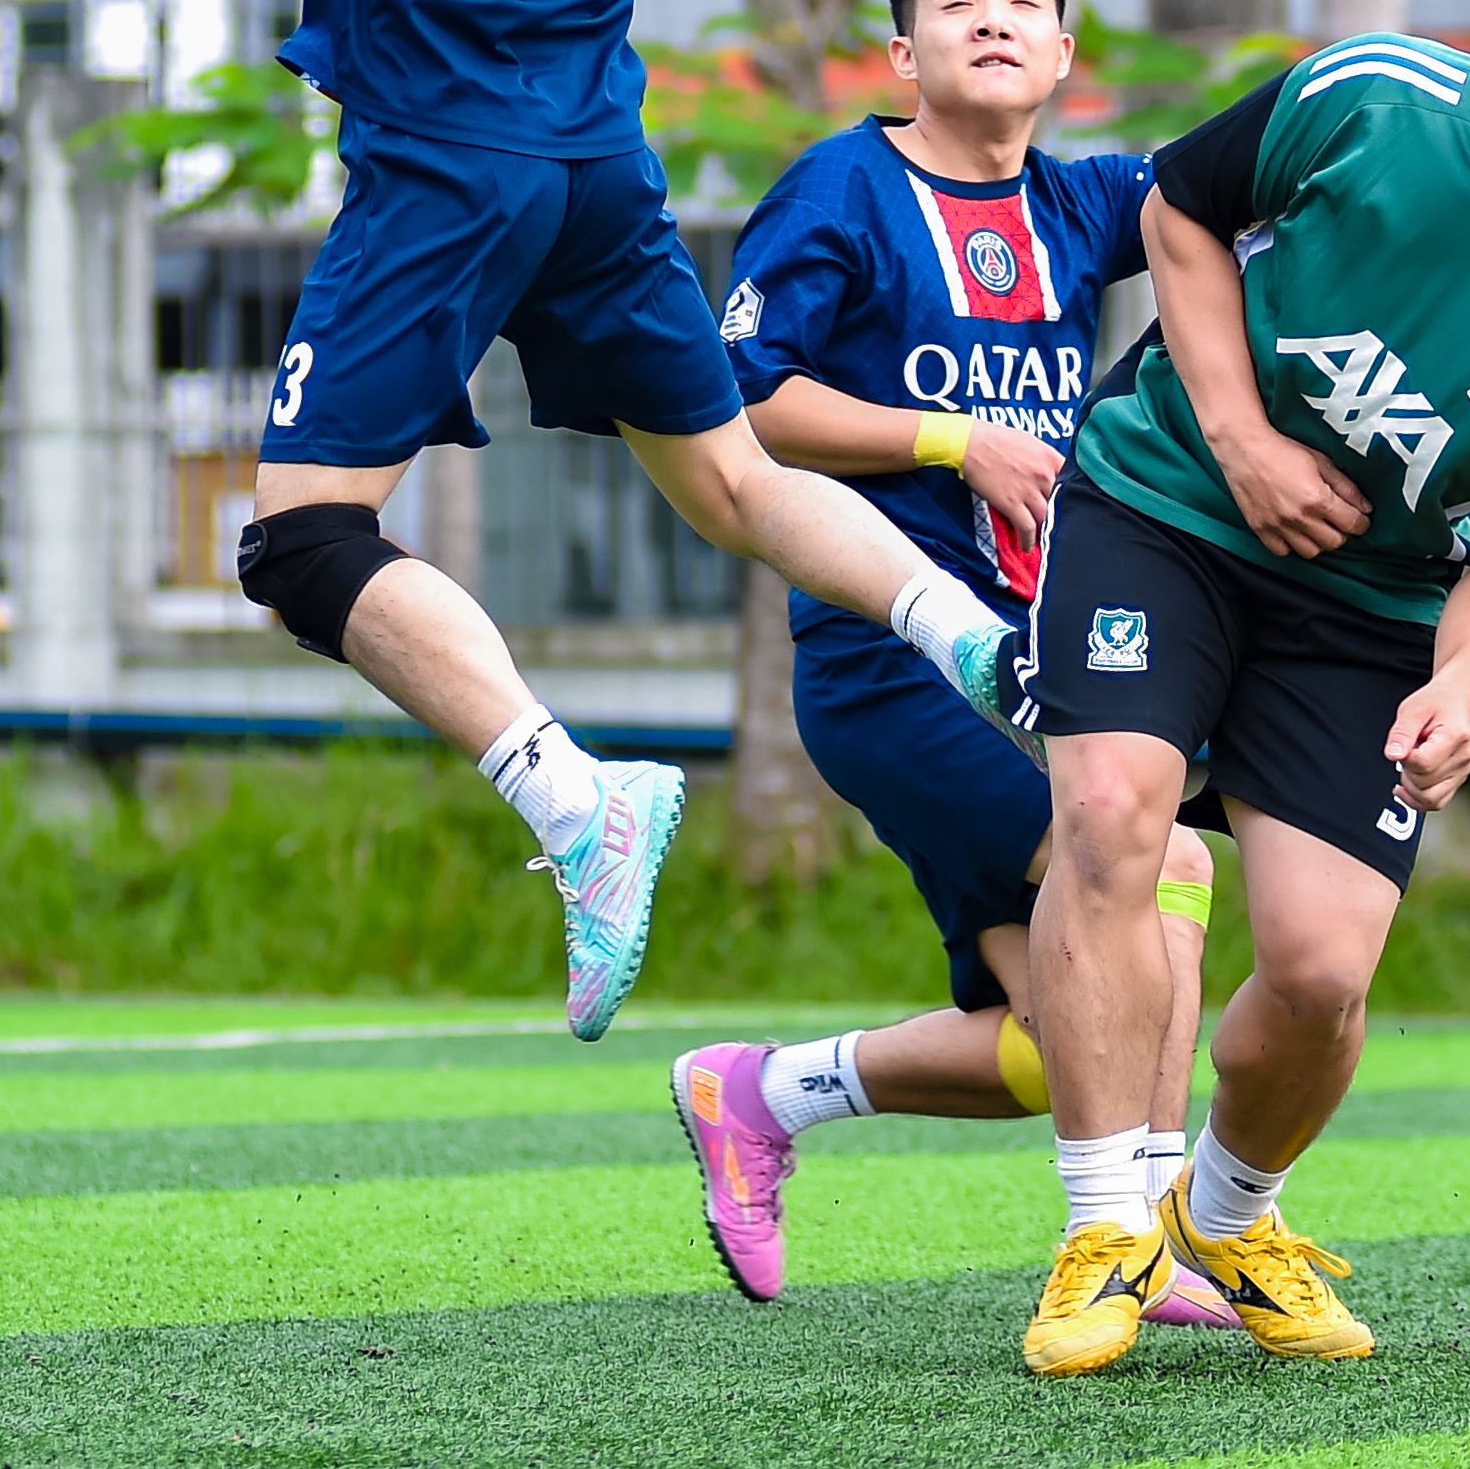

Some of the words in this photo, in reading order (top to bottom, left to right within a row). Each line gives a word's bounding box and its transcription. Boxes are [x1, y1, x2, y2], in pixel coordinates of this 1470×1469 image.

[272, 341, 314, 427] 3
[903, 343, 1083, 411] QATAR
[1275, 329, 1455, 514] AXA
